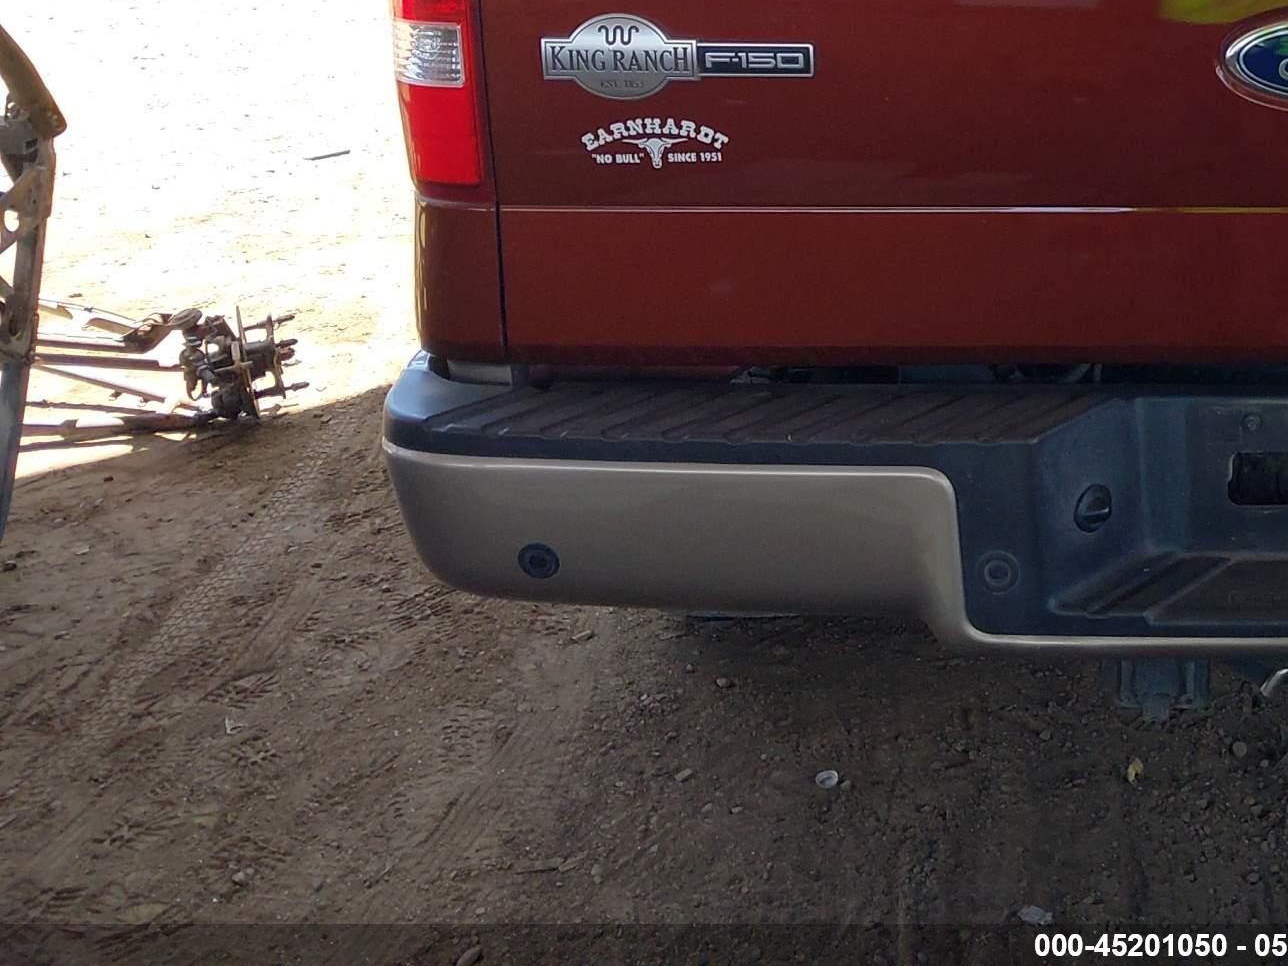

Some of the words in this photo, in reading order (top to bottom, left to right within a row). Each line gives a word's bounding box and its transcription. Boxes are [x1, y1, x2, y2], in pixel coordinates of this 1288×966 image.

[550, 45, 606, 72] KING
[612, 47, 690, 73] RANCH
[704, 52, 804, 70] F-150
[581, 117, 729, 152] EARNHARDT
[591, 153, 613, 164] "NO
[615, 153, 645, 164] BULL"
[667, 152, 697, 163] SINCE
[700, 152, 722, 163] 1951
